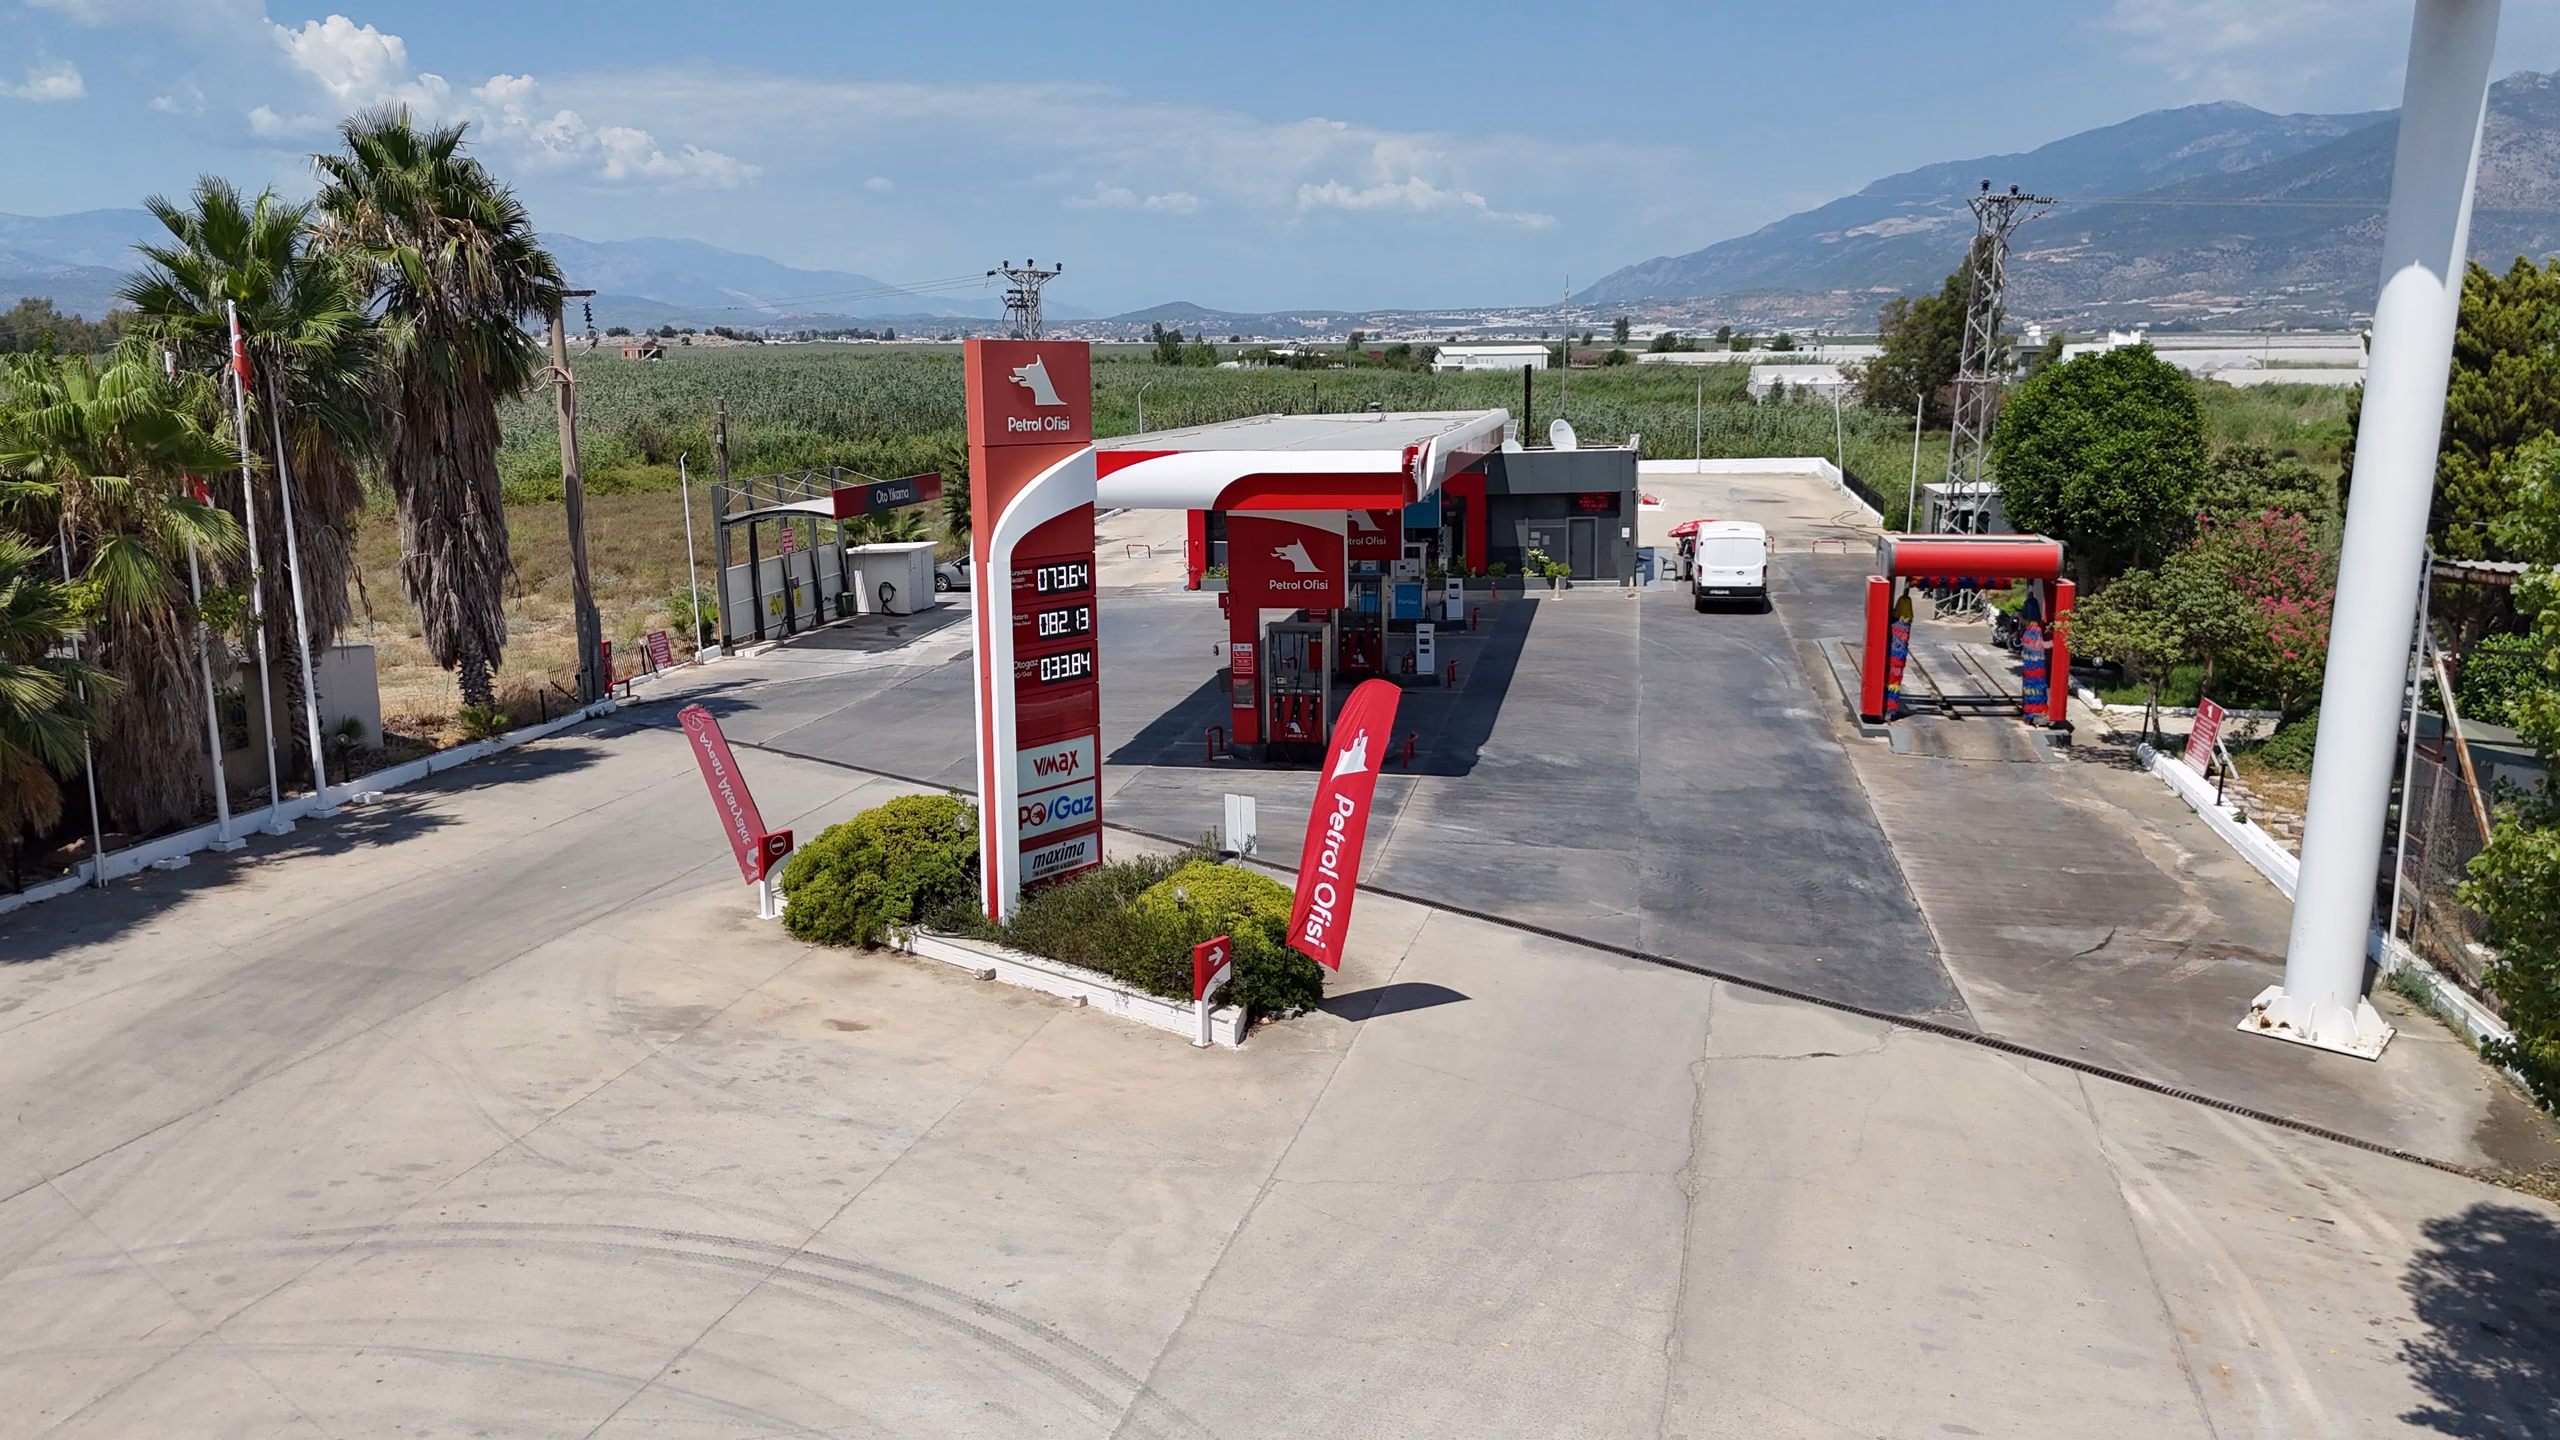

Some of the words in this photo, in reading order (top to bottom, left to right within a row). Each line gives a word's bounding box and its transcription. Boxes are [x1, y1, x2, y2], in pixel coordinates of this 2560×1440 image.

[1008, 416, 1041, 432] Petrol
[1044, 416, 1070, 431] Ofisi
[876, 490, 888, 503] Oto
[1365, 536, 1387, 545] Ofisi
[1037, 564, 1088, 591] 073.64
[1269, 580, 1301, 590] Petrol
[1303, 579, 1329, 590] Ofisi
[1039, 607, 1089, 636] 082.13
[1014, 659, 1039, 670] Otogaz
[1041, 652, 1091, 681] 033.84
[2206, 704, 2213, 719] 1
[1318, 792, 1355, 881] Petrol
[1032, 842, 1085, 870] maxima
[1304, 882, 1336, 949] Ofisi
